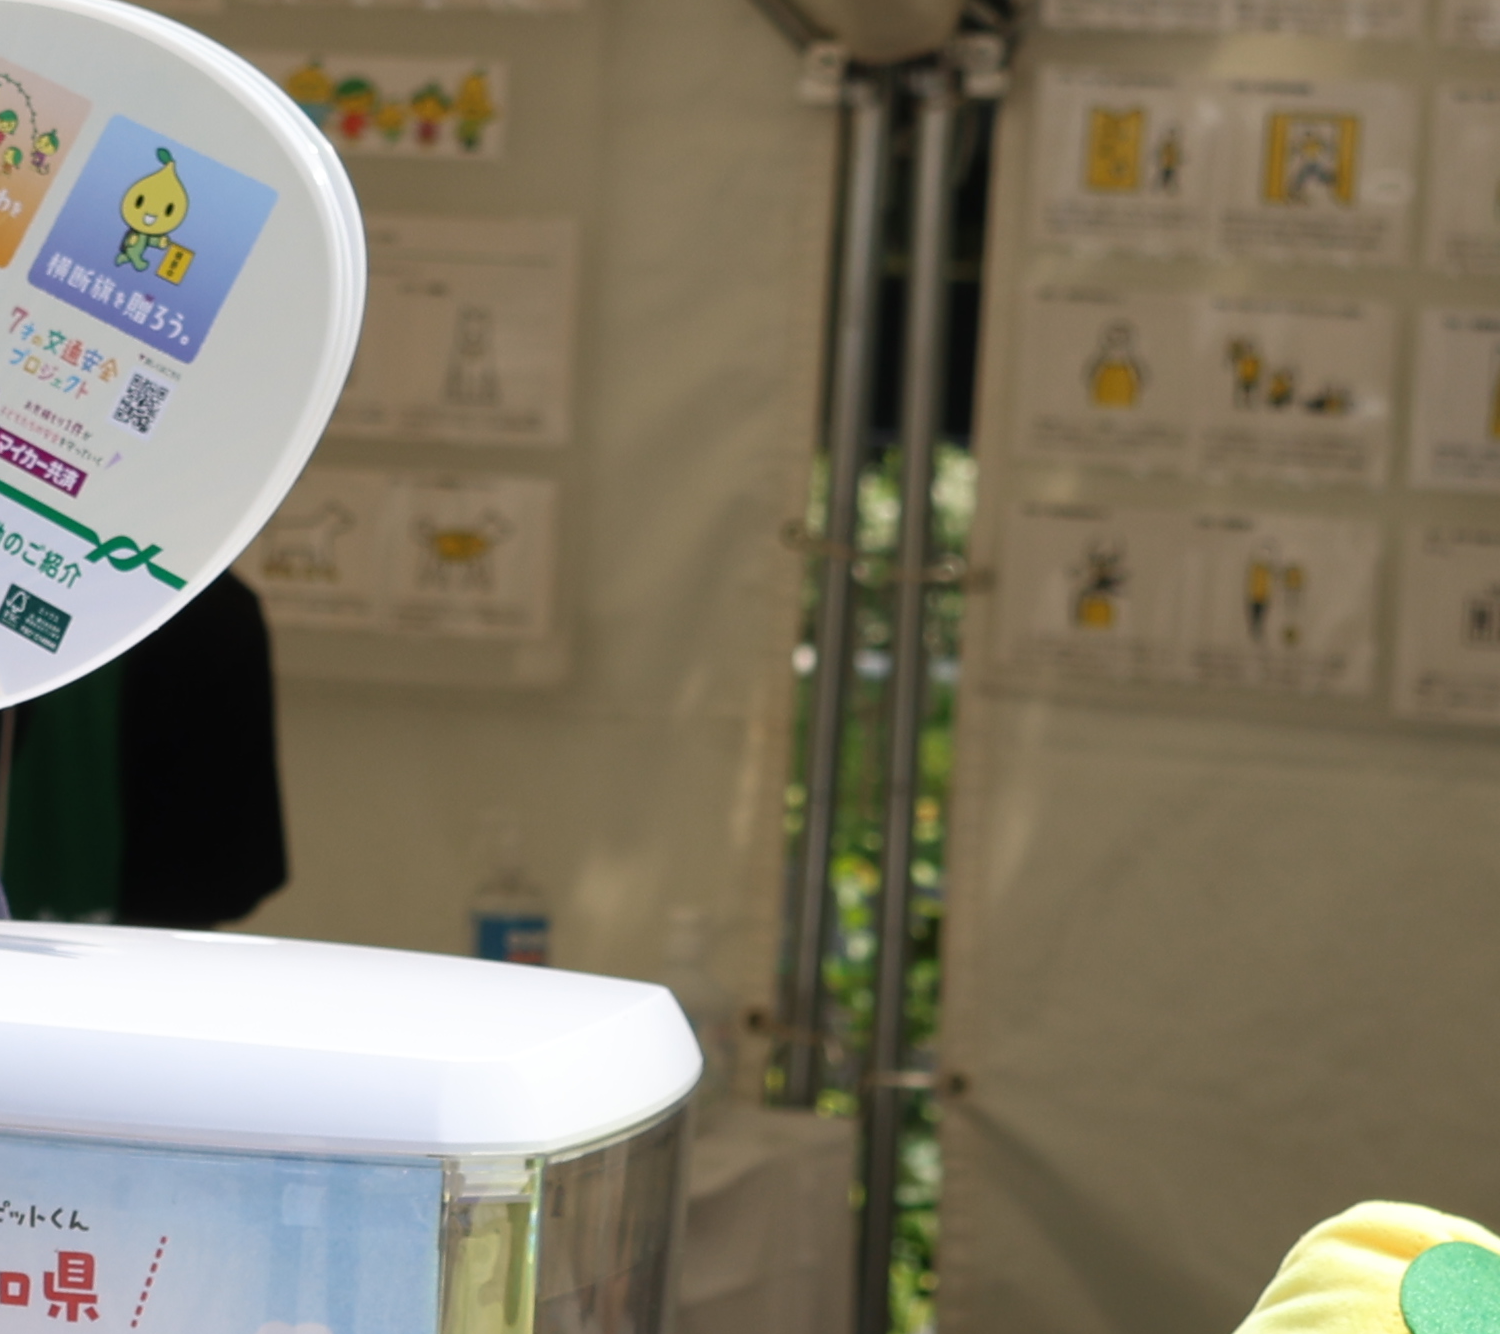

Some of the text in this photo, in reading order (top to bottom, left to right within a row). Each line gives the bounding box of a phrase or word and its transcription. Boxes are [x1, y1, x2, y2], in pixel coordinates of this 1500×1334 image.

[8, 305, 119, 383] 7才の交通安全
[8, 348, 89, 399] プロジェクト
